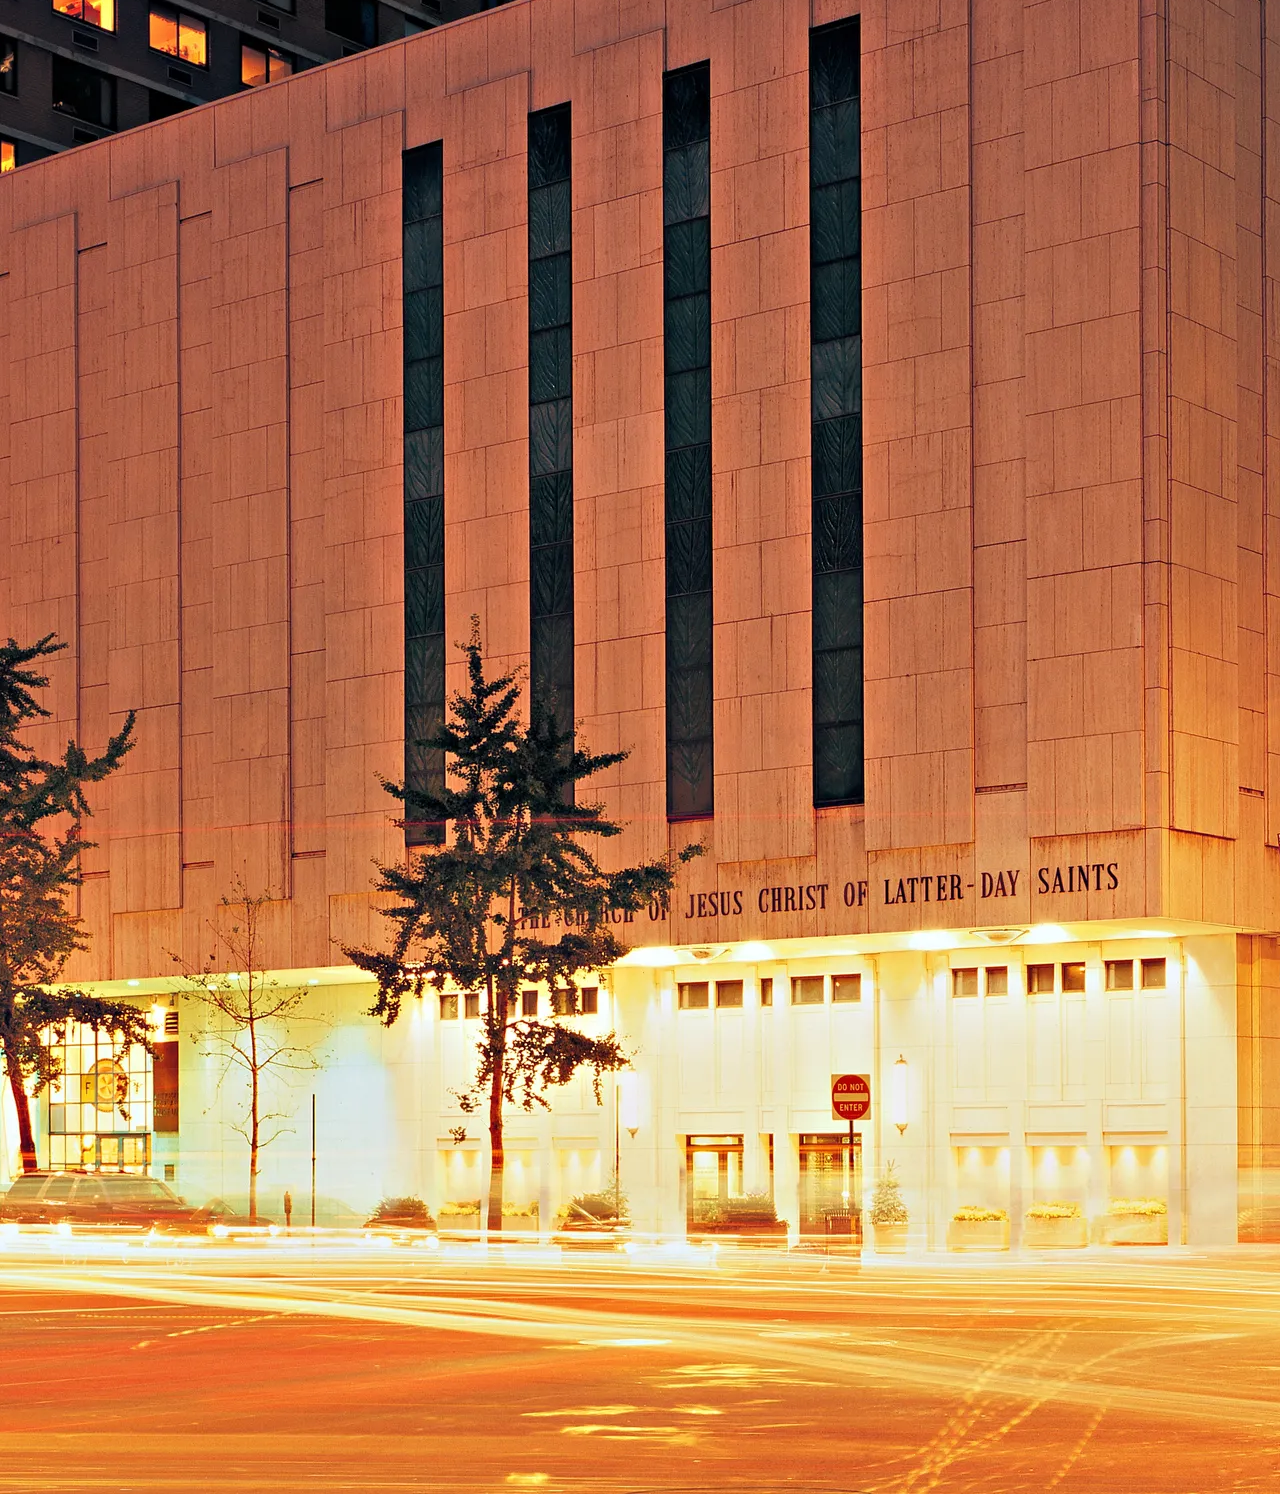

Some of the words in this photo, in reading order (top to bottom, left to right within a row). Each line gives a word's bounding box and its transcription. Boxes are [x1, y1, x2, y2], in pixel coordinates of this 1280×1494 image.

[686, 891, 743, 919] JESUS
[758, 883, 829, 912] CHRIST
[843, 880, 869, 907] OF
[883, 868, 1020, 904] LATTER-DAY
[1037, 862, 1120, 895] SAINTS
[837, 1083, 848, 1091] DO
[850, 1083, 864, 1091] NOT
[840, 1103, 863, 1112] ENTER
